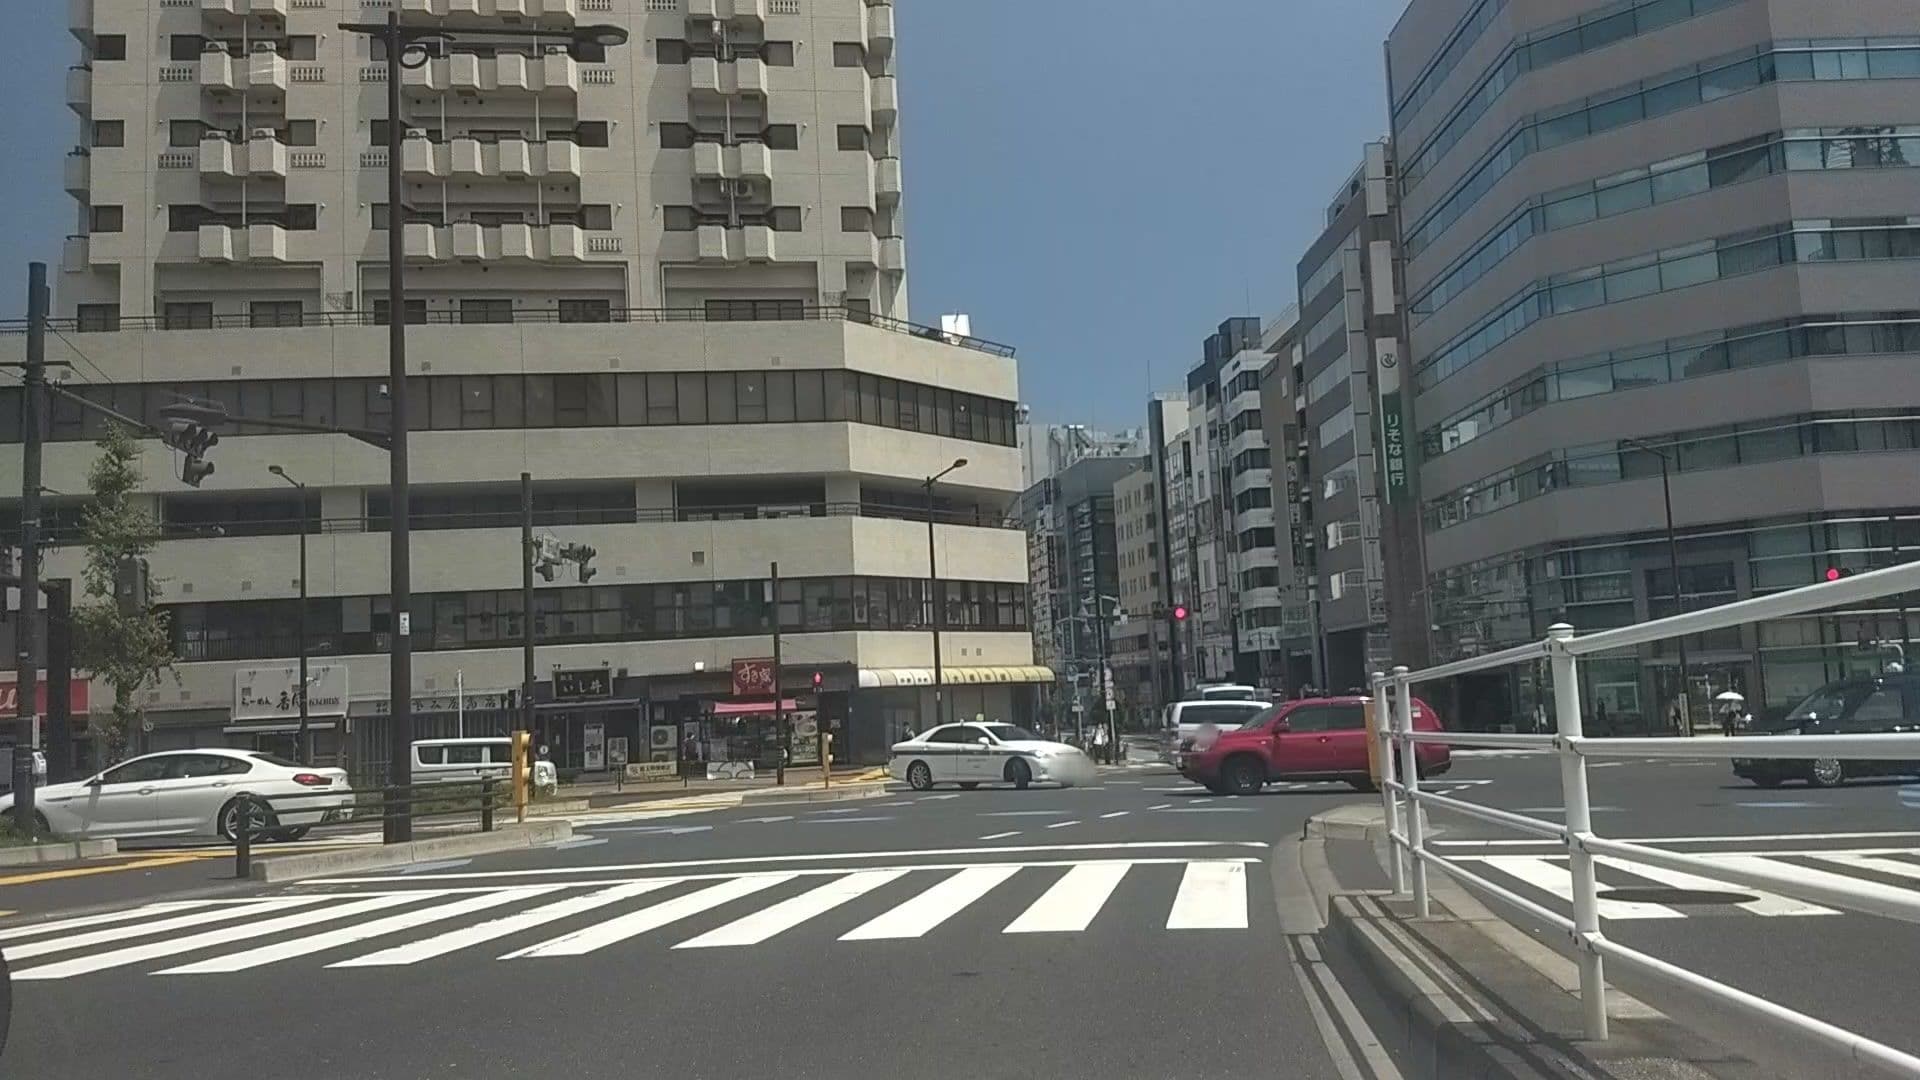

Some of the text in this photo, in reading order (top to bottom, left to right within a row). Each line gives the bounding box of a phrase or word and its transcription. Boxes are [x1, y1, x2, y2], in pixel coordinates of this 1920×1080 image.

[1387, 414, 1404, 486] りそな銀行
[737, 663, 772, 684] すき家
